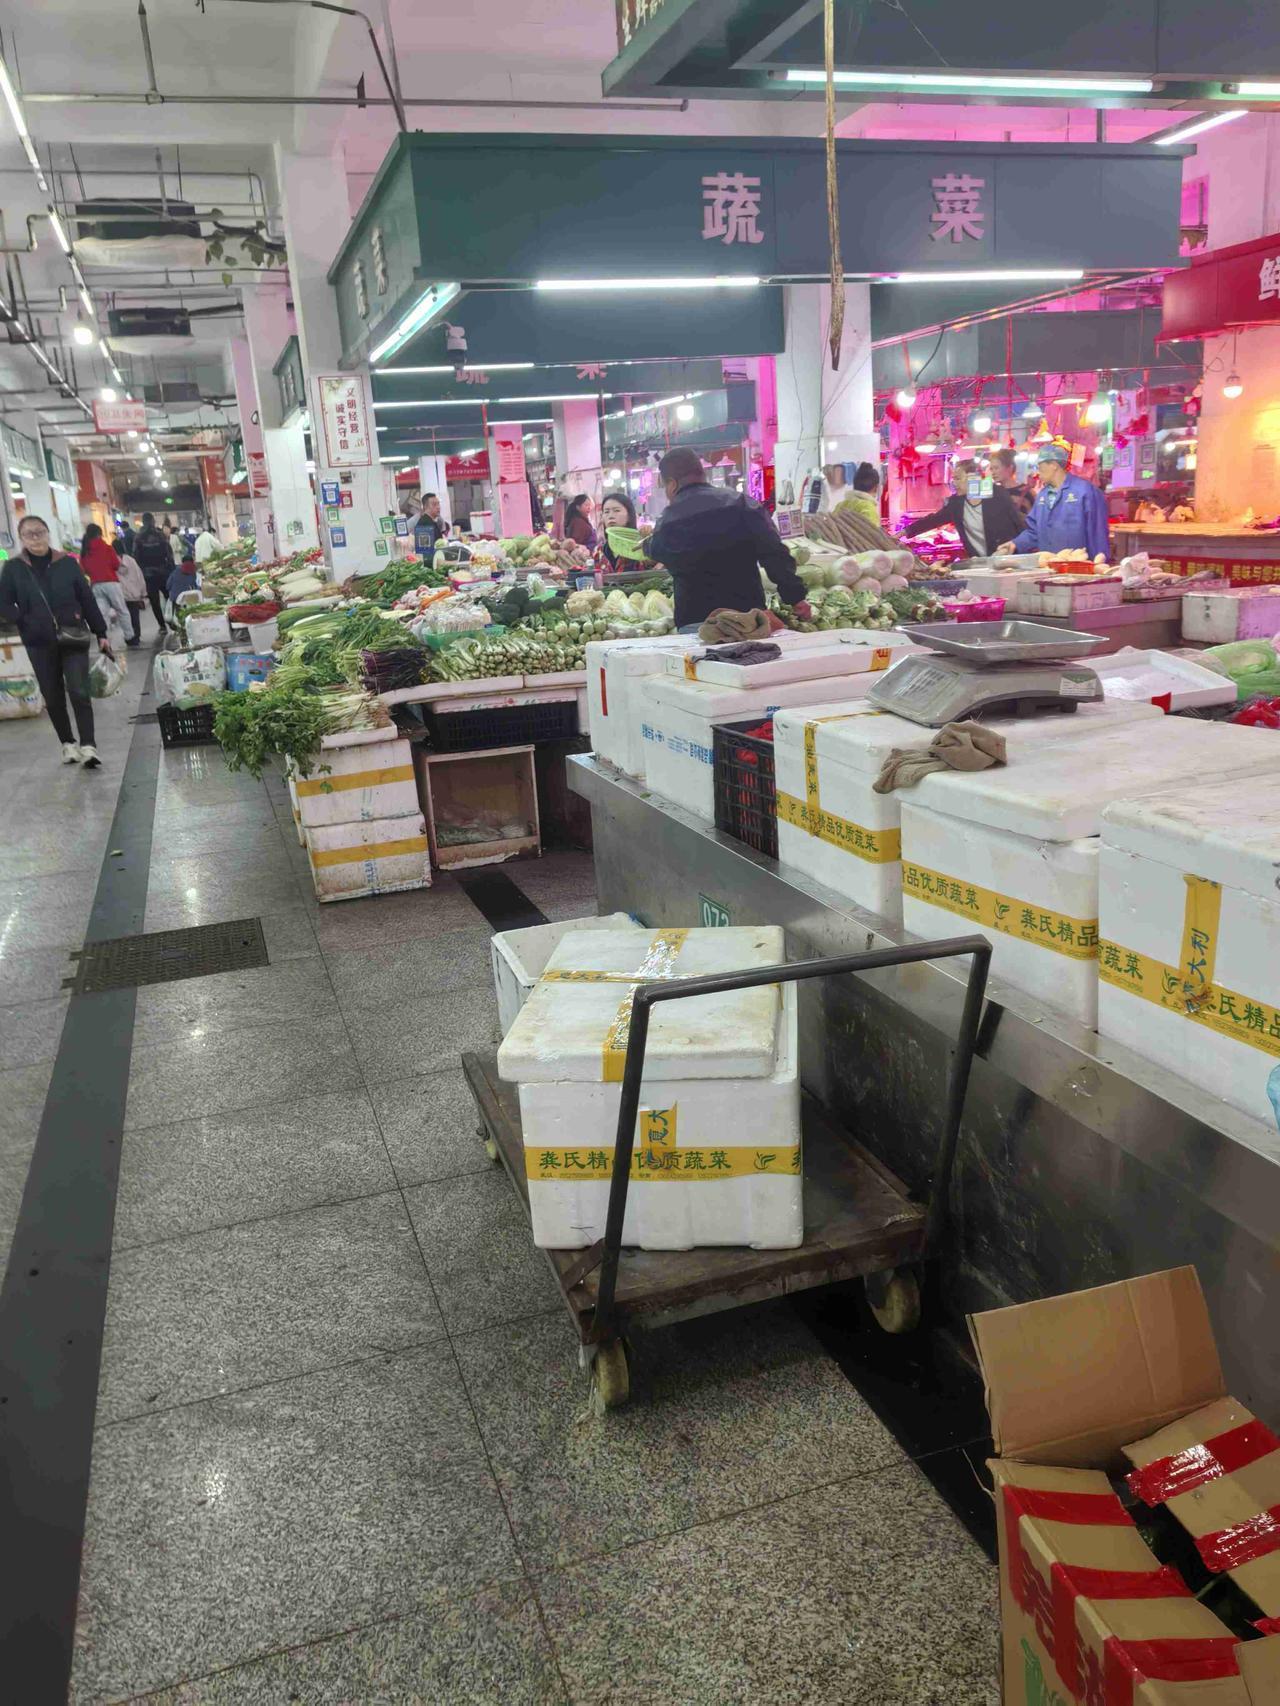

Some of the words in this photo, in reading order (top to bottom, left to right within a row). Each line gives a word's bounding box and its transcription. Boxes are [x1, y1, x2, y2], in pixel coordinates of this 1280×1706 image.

[902, 864, 980, 910] 品优质蔬菜
[1097, 942, 1143, 980] 蔬菜
